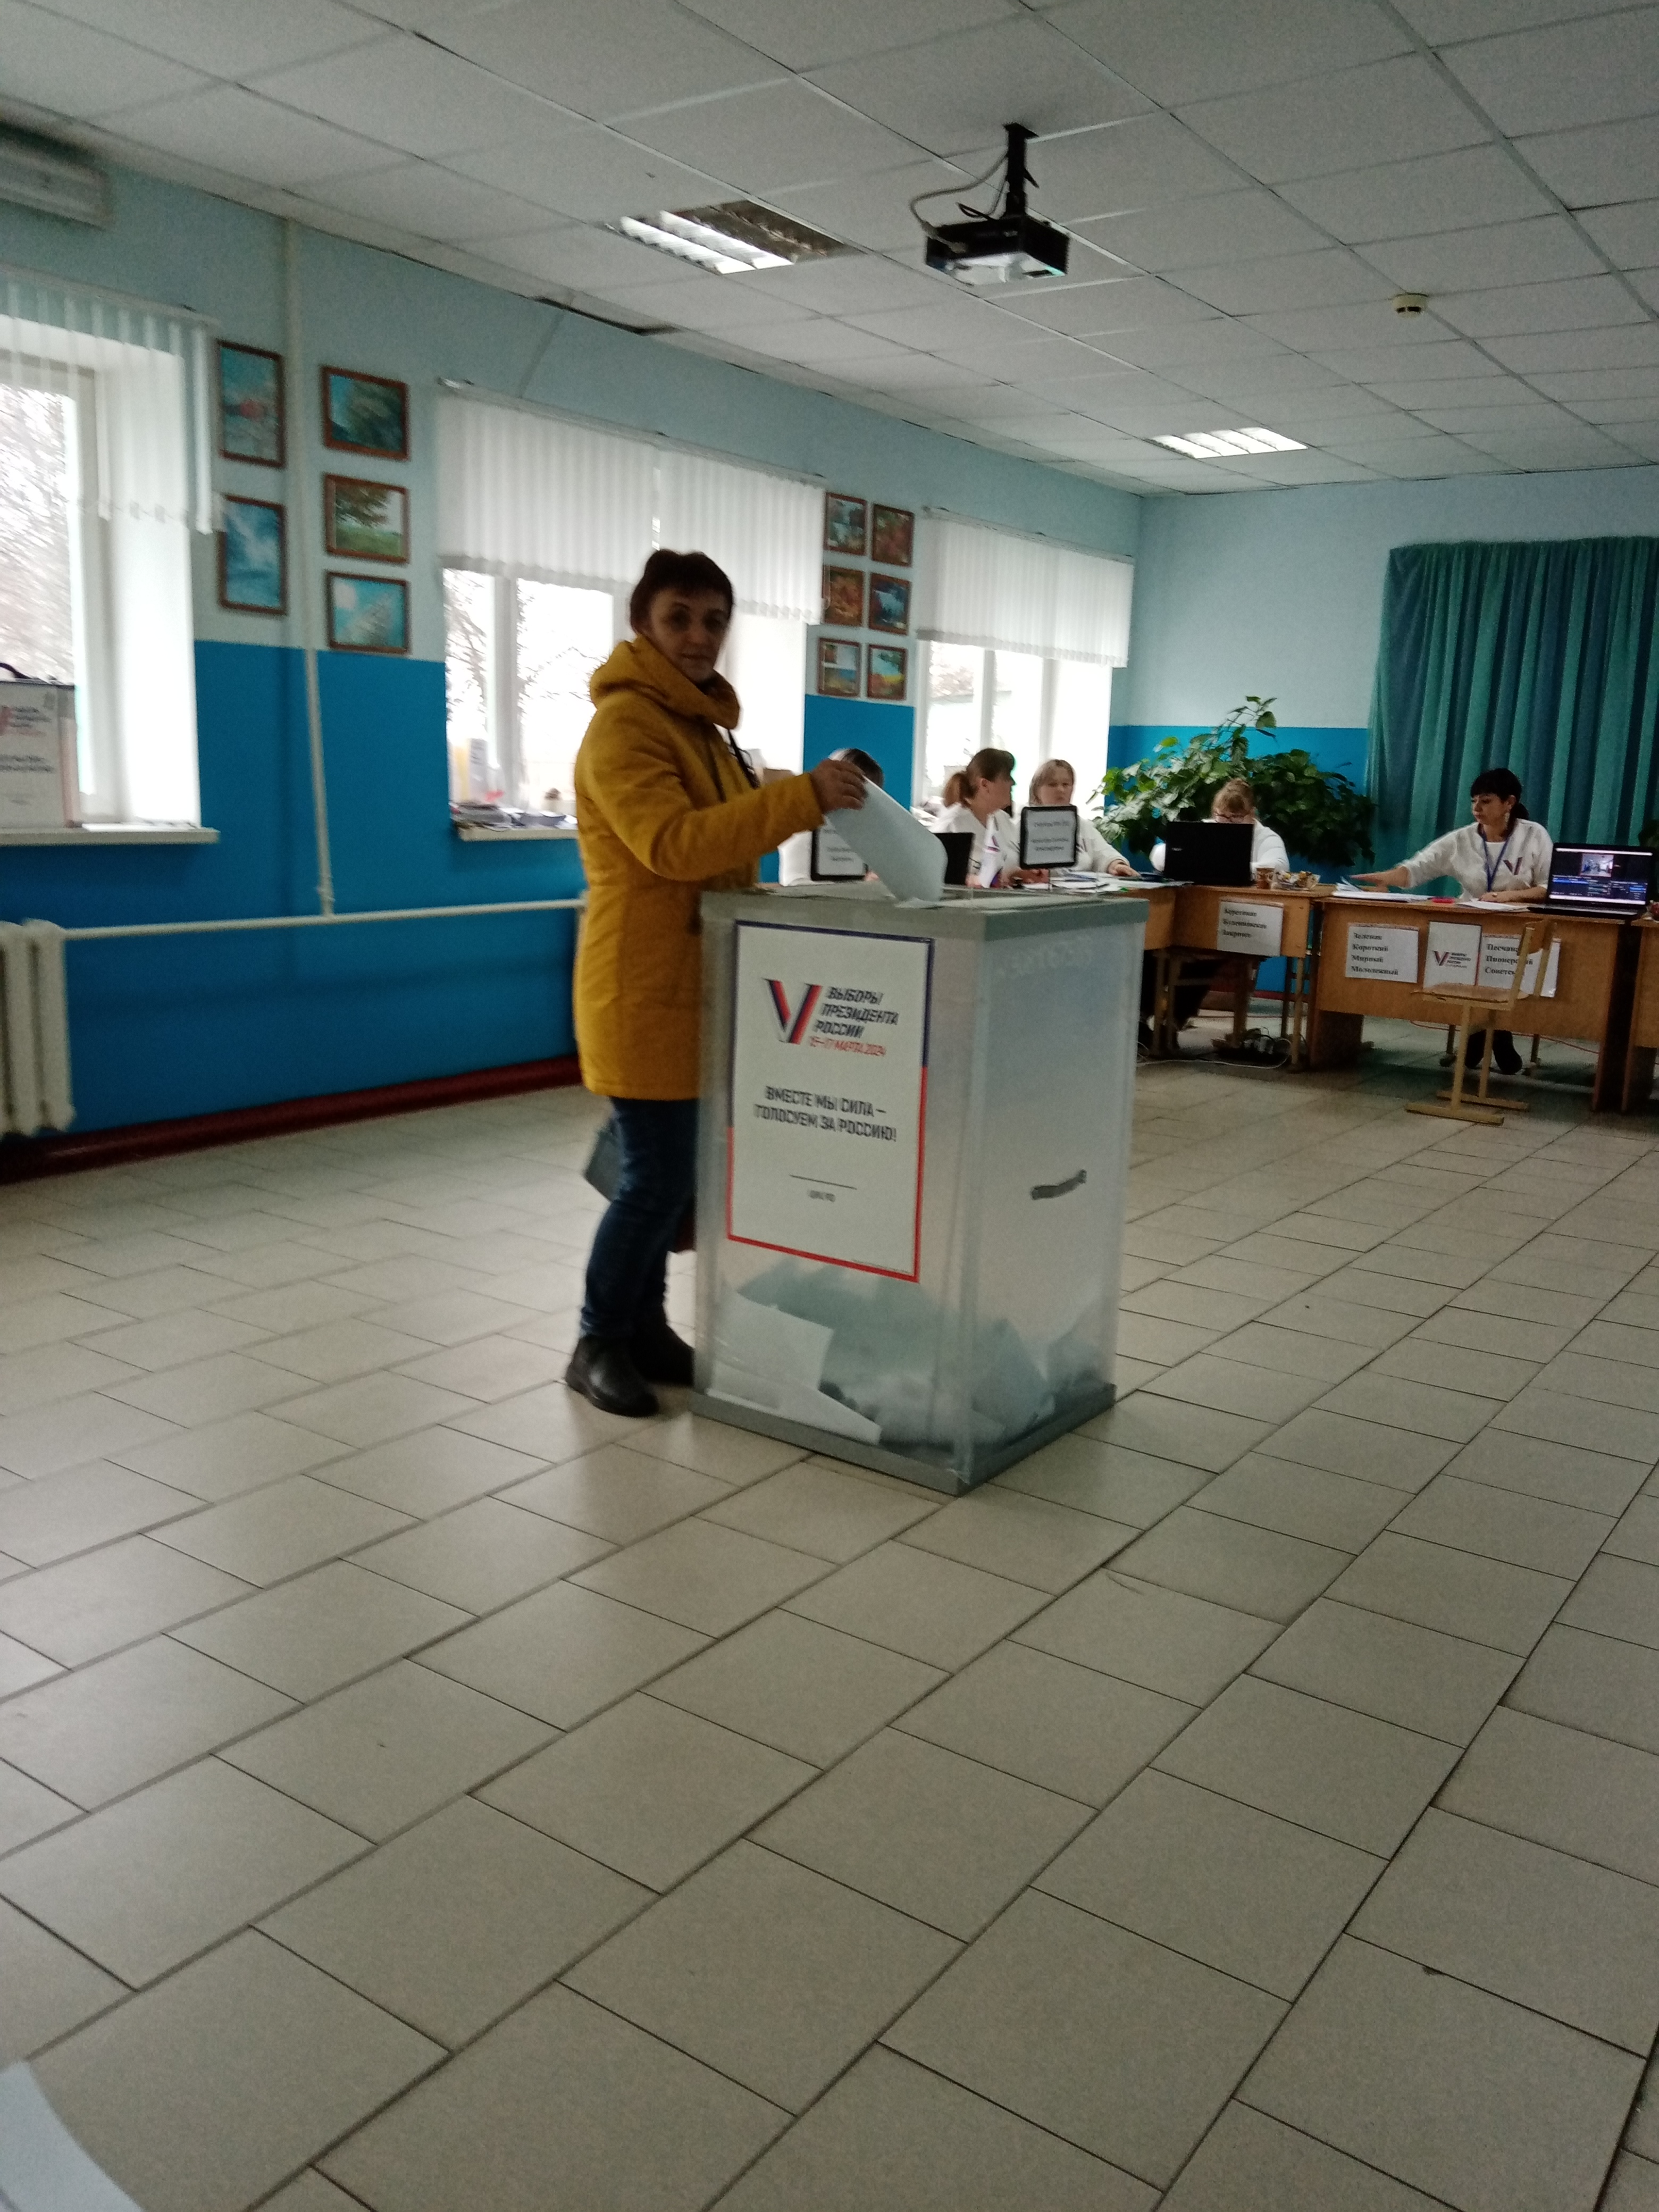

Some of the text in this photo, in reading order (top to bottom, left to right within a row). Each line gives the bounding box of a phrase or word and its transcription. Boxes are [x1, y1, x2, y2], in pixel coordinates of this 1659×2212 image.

[825, 986, 884, 1005] ВЫБОРЫ
[822, 1002, 900, 1025] ПРЕЗИДЕНТА
[813, 1019, 865, 1038] РОССИИ
[765, 1085, 813, 1107] ВМЕСТЕ
[815, 1093, 837, 1111] МЫ
[841, 1097, 875, 1117] СИЛА
[754, 1104, 896, 1142] ГОЛОСУЕМ ЗА РОССИЮ!
